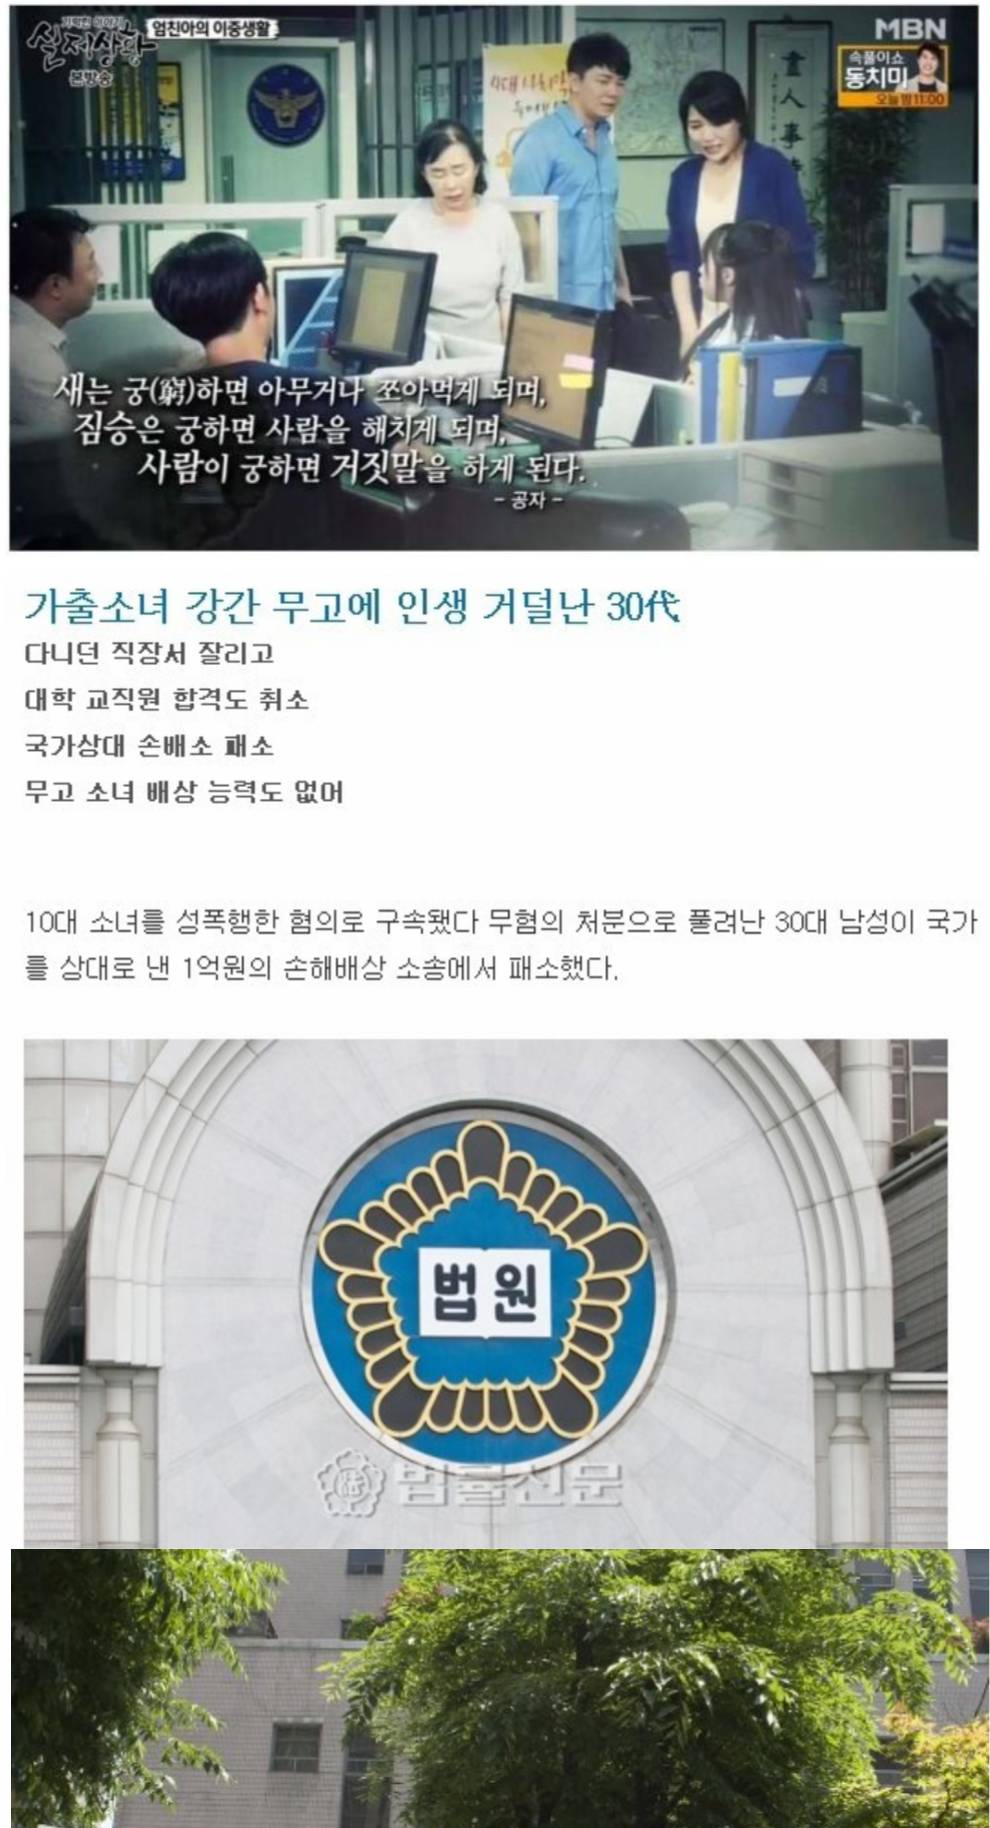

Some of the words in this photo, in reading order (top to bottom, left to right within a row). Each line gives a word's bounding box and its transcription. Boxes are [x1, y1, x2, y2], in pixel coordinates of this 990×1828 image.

[26, 588, 167, 624] 가출소녀
[187, 588, 260, 624] 강간
[274, 588, 379, 624] 무고에
[399, 588, 466, 624] 인생
[484, 588, 595, 624] 거덜난
[608, 590, 680, 622] 30代
[26, 642, 98, 665] 다니던
[113, 642, 185, 665] 직장서
[200, 642, 273, 665] 잘리고
[26, 688, 75, 711] 대학
[87, 688, 159, 711] 교직원
[174, 688, 247, 711] 합격도
[260, 688, 308, 711] 취소
[26, 735, 124, 757] 국가상대
[139, 735, 212, 757] 손배소
[225, 735, 273, 757] 패소
[26, 781, 74, 803] 무고
[87, 781, 133, 803] 소녀
[148, 781, 197, 803] 배상
[209, 781, 282, 803] 능력도
[295, 781, 342, 803] 없어
[28, 910, 76, 934] 10대
[90, 910, 164, 934] 소녀를
[177, 909, 279, 934] 성폭행한
[290, 910, 364, 934] 혐의로
[377, 910, 478, 934] 구속됐다
[490, 909, 562, 934] 무혐의
[576, 910, 676, 934] 처분으로
[689, 910, 765, 934] 풀려난
[776, 910, 826, 934] 30대
[840, 910, 914, 934] 남성이
[928, 909, 977, 934] 국가
[26, 956, 48, 980] 를
[61, 956, 135, 980] 상대로
[147, 956, 168, 980] 낸
[185, 956, 270, 980] 1억원의
[284, 956, 386, 980] 손해배상
[397, 956, 495, 980] 소송에서
[510, 956, 617, 980] 패소했다.
[434, 1263, 537, 1322] 법원
